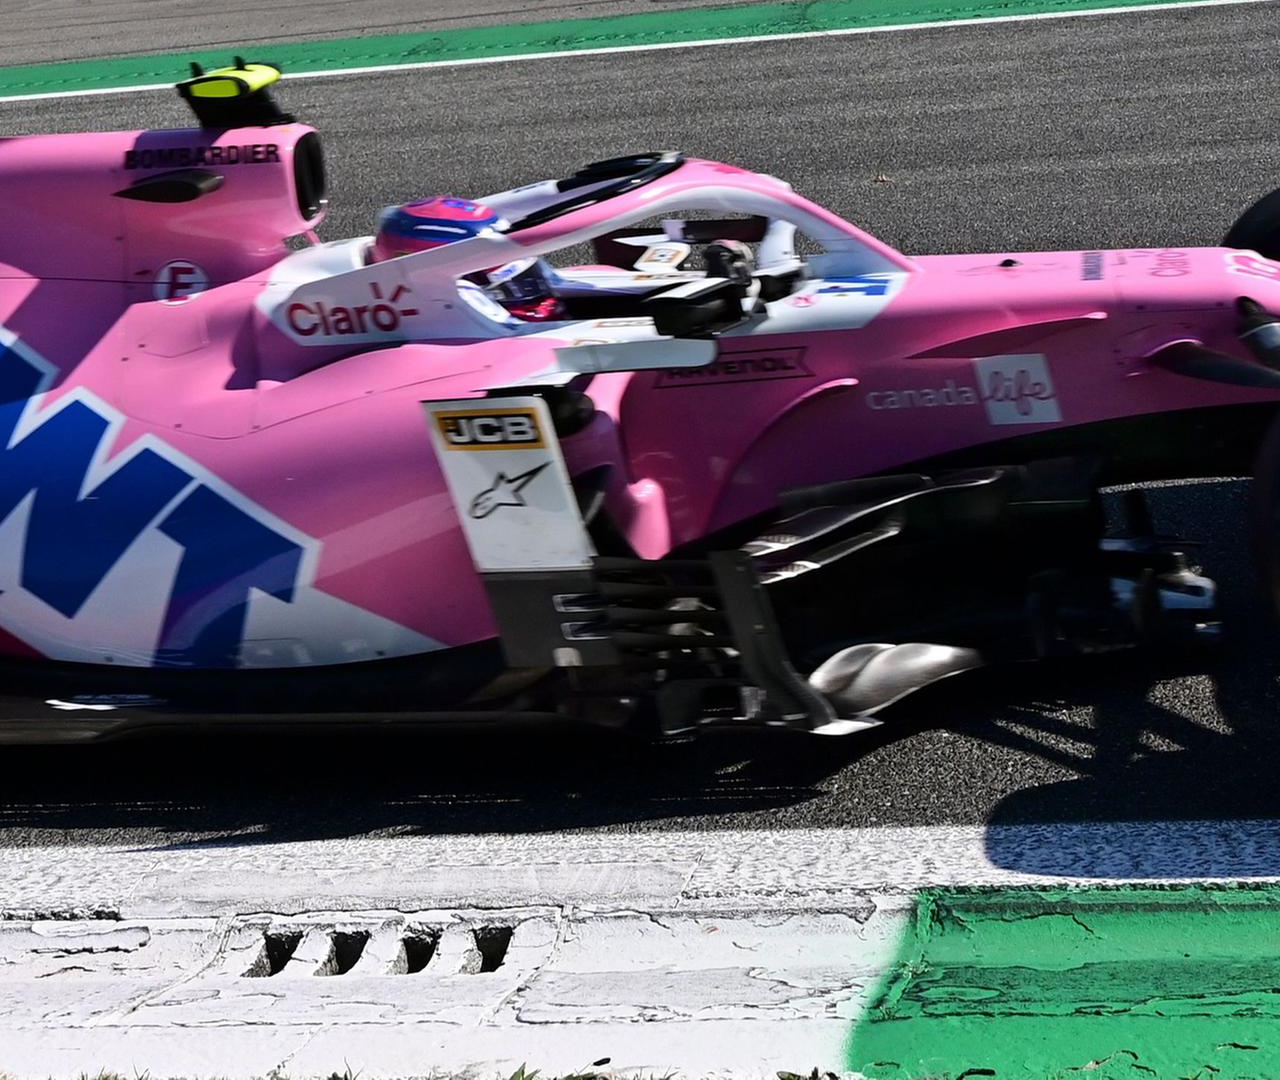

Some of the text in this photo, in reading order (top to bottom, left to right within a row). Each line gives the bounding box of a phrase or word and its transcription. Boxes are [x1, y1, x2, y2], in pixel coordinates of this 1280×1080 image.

[124, 143, 280, 169] BOMBARDIER
[286, 301, 402, 337] Claro
[866, 370, 1057, 416] canada life
[445, 416, 537, 444] JCB
